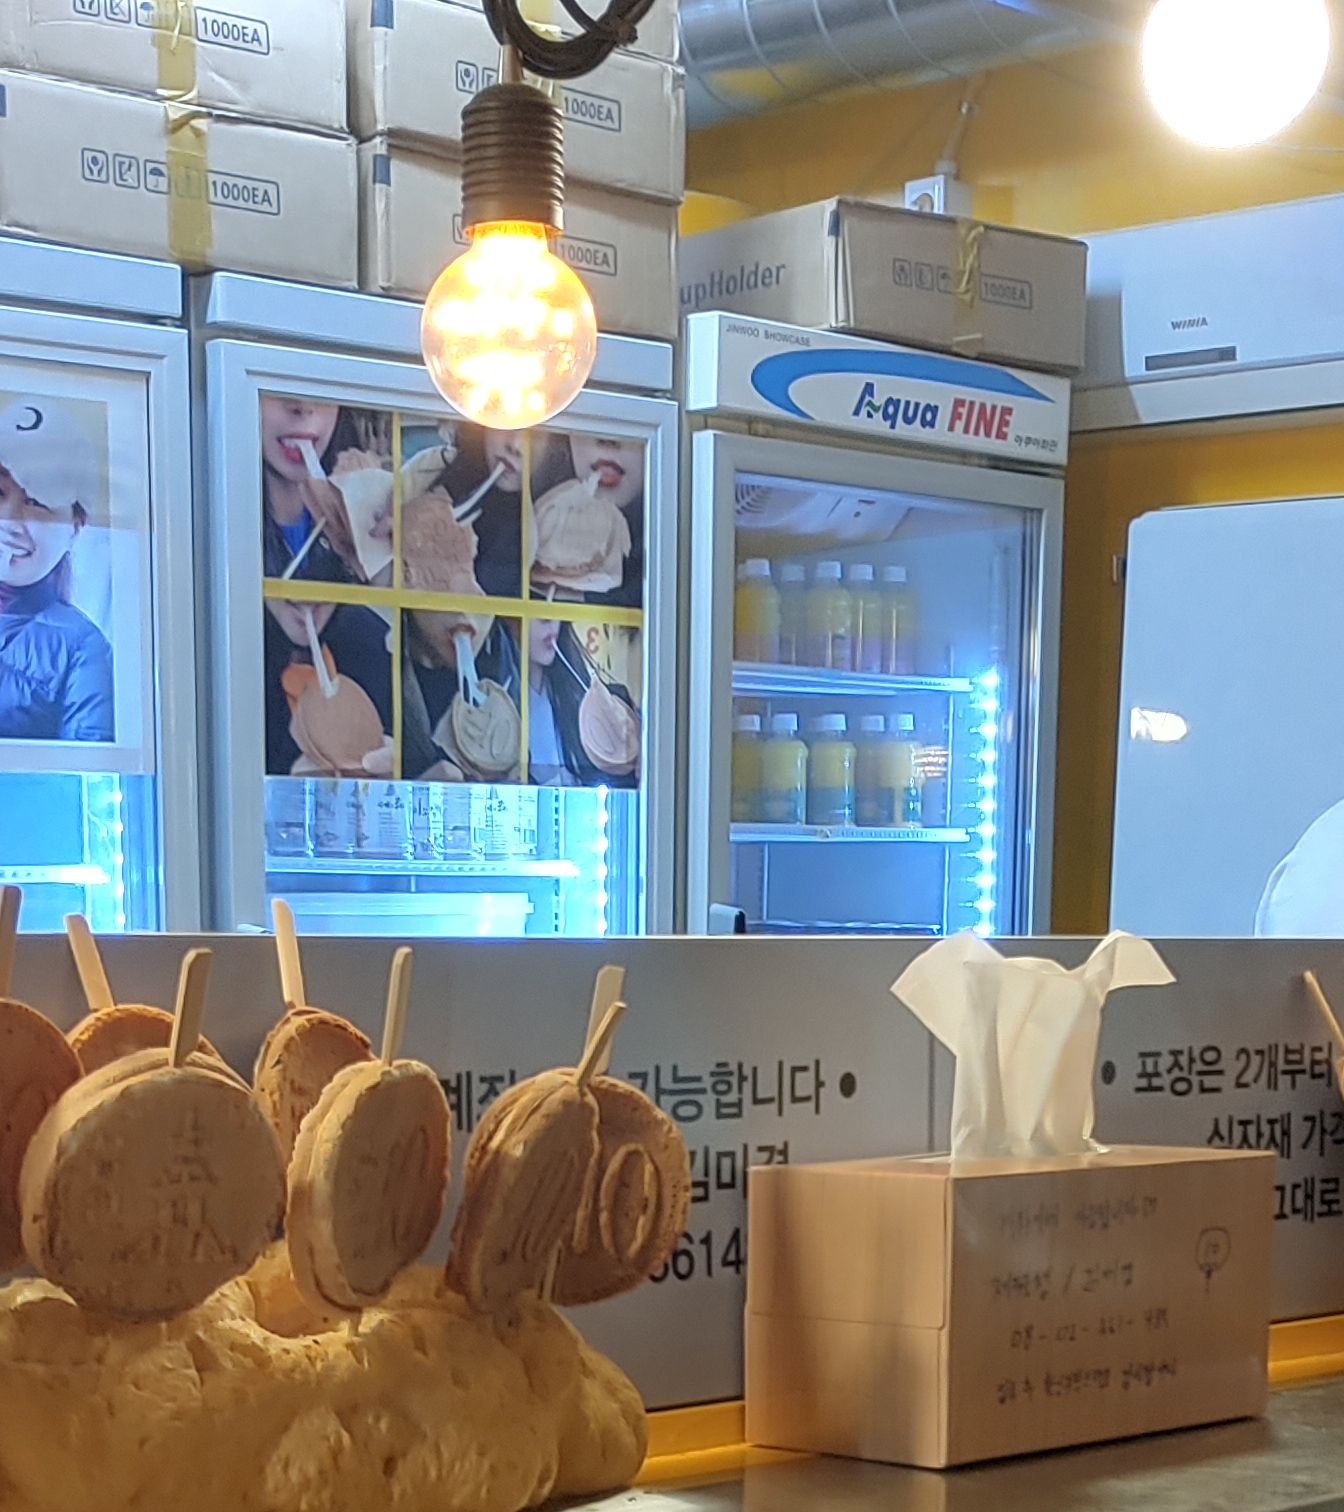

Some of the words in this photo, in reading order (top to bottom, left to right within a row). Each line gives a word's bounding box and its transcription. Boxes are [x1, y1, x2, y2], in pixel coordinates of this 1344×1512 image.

[201, 17, 262, 46] 1000EA
[211, 180, 273, 209] 1000EA
[853, 381, 939, 429] Aqua
[947, 398, 1015, 442] FINE
[1132, 1044, 1226, 1098] 포장은
[1233, 1041, 1335, 1092] 2개부터
